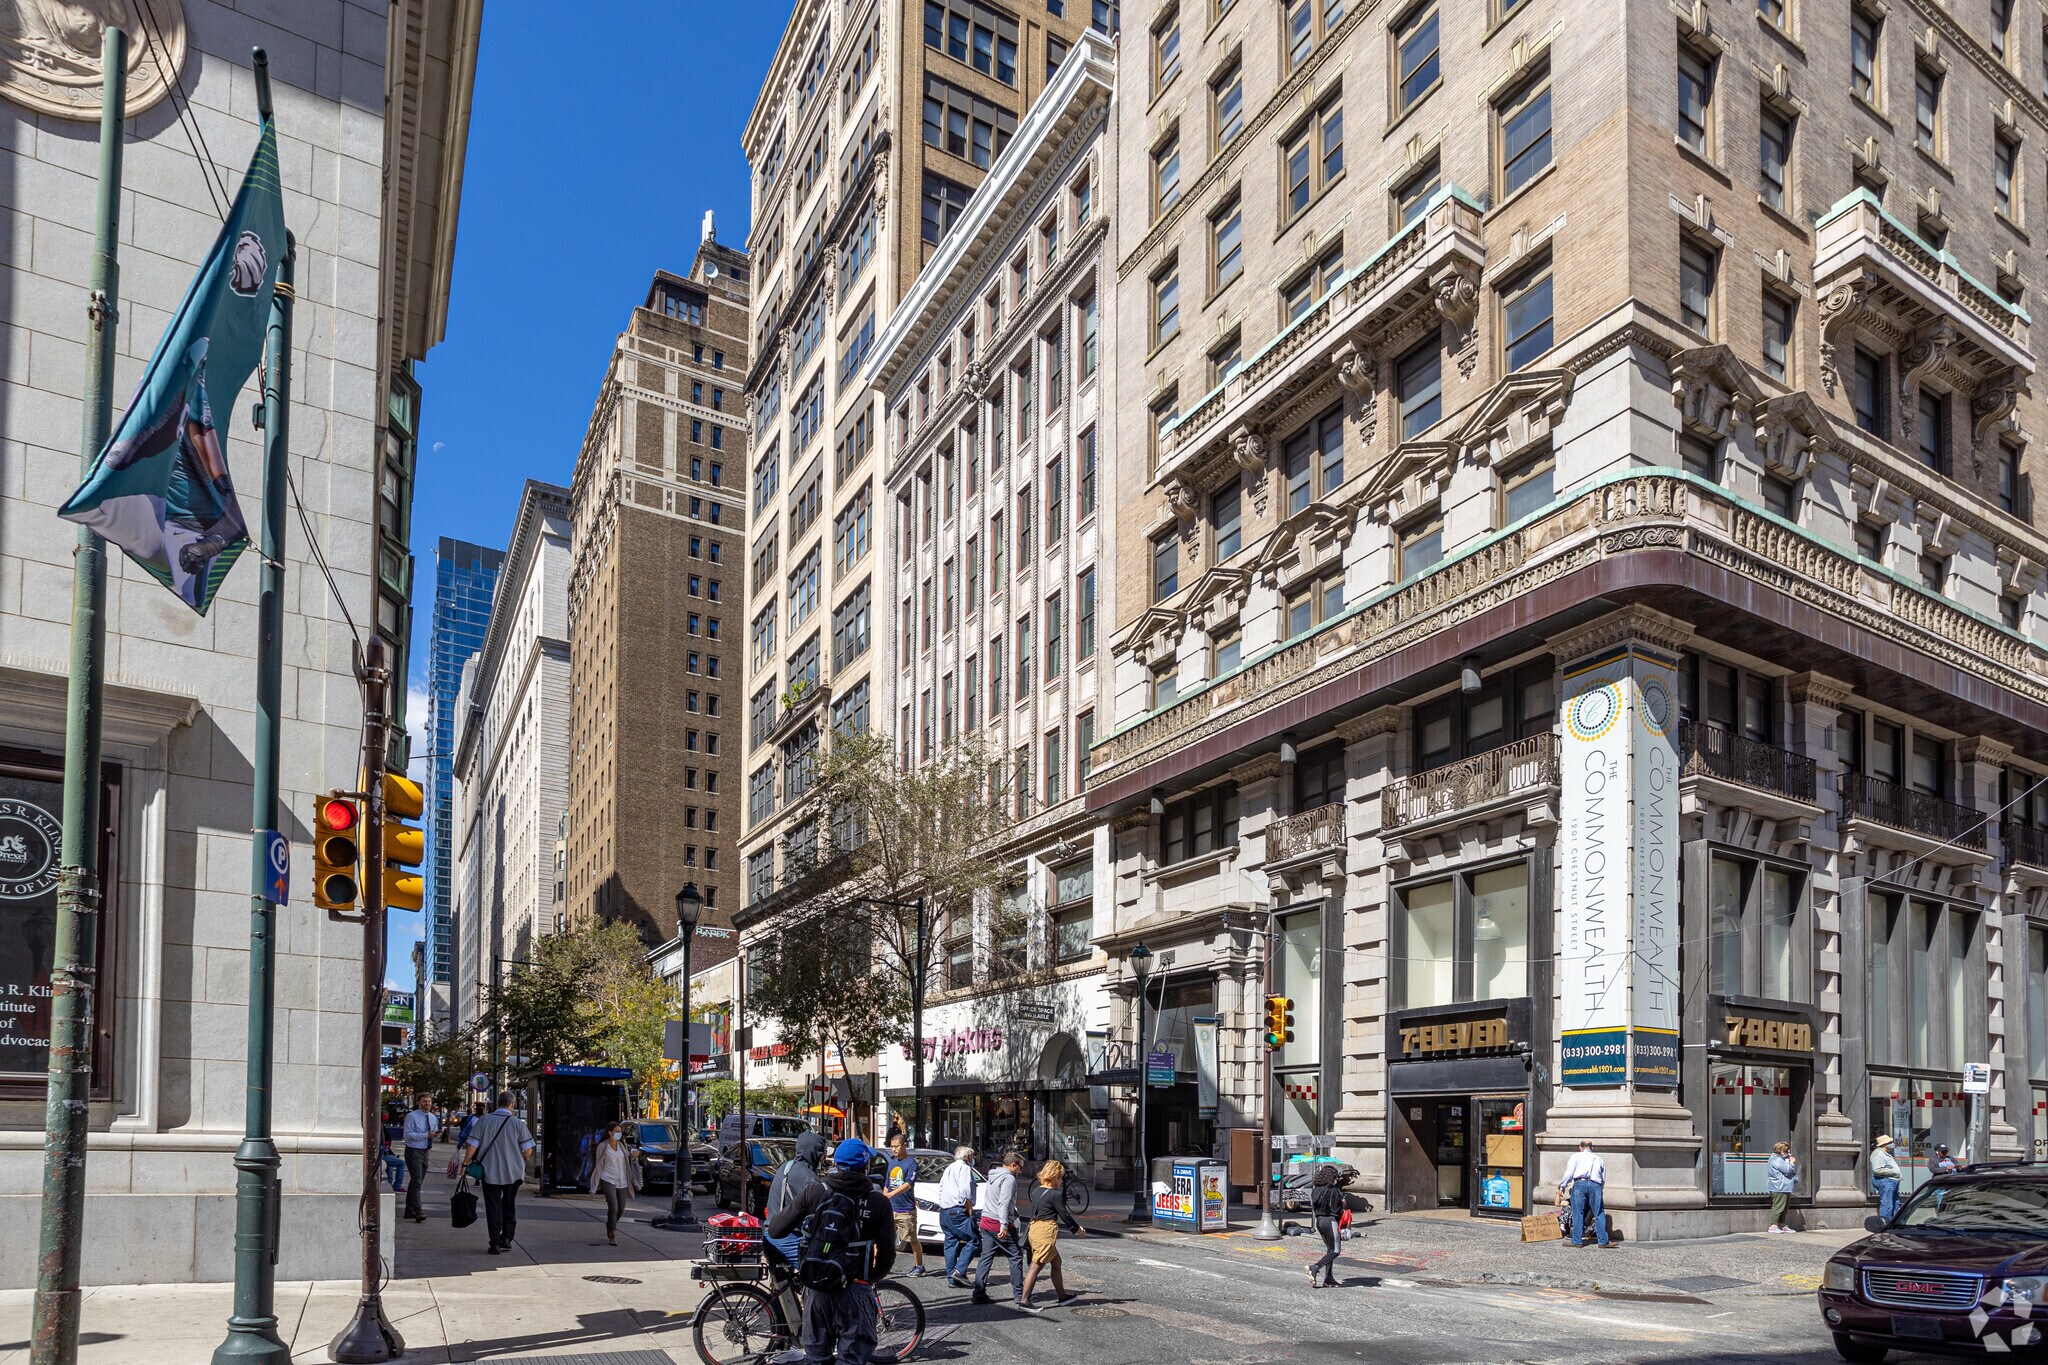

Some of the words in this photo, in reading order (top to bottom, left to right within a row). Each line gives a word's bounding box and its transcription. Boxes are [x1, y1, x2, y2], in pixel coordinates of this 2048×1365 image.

[1609, 760, 1617, 781] THE
[34, 814, 62, 854] KLINE
[15, 884, 34, 894] OF
[37, 863, 60, 888] LAW
[1585, 750, 1606, 1011] COMMONWEALTH
[1649, 746, 1664, 1010] COMMONWEALTH
[8, 984, 24, 996] R.
[28, 985, 54, 998] Kli
[0, 1017, 17, 1029] of
[0, 1033, 50, 1047] dvocac
[941, 1027, 1003, 1060] pickins
[1563, 1065, 1625, 1075] commonwealth1201.com
[1896, 1281, 1944, 1295] GMC
